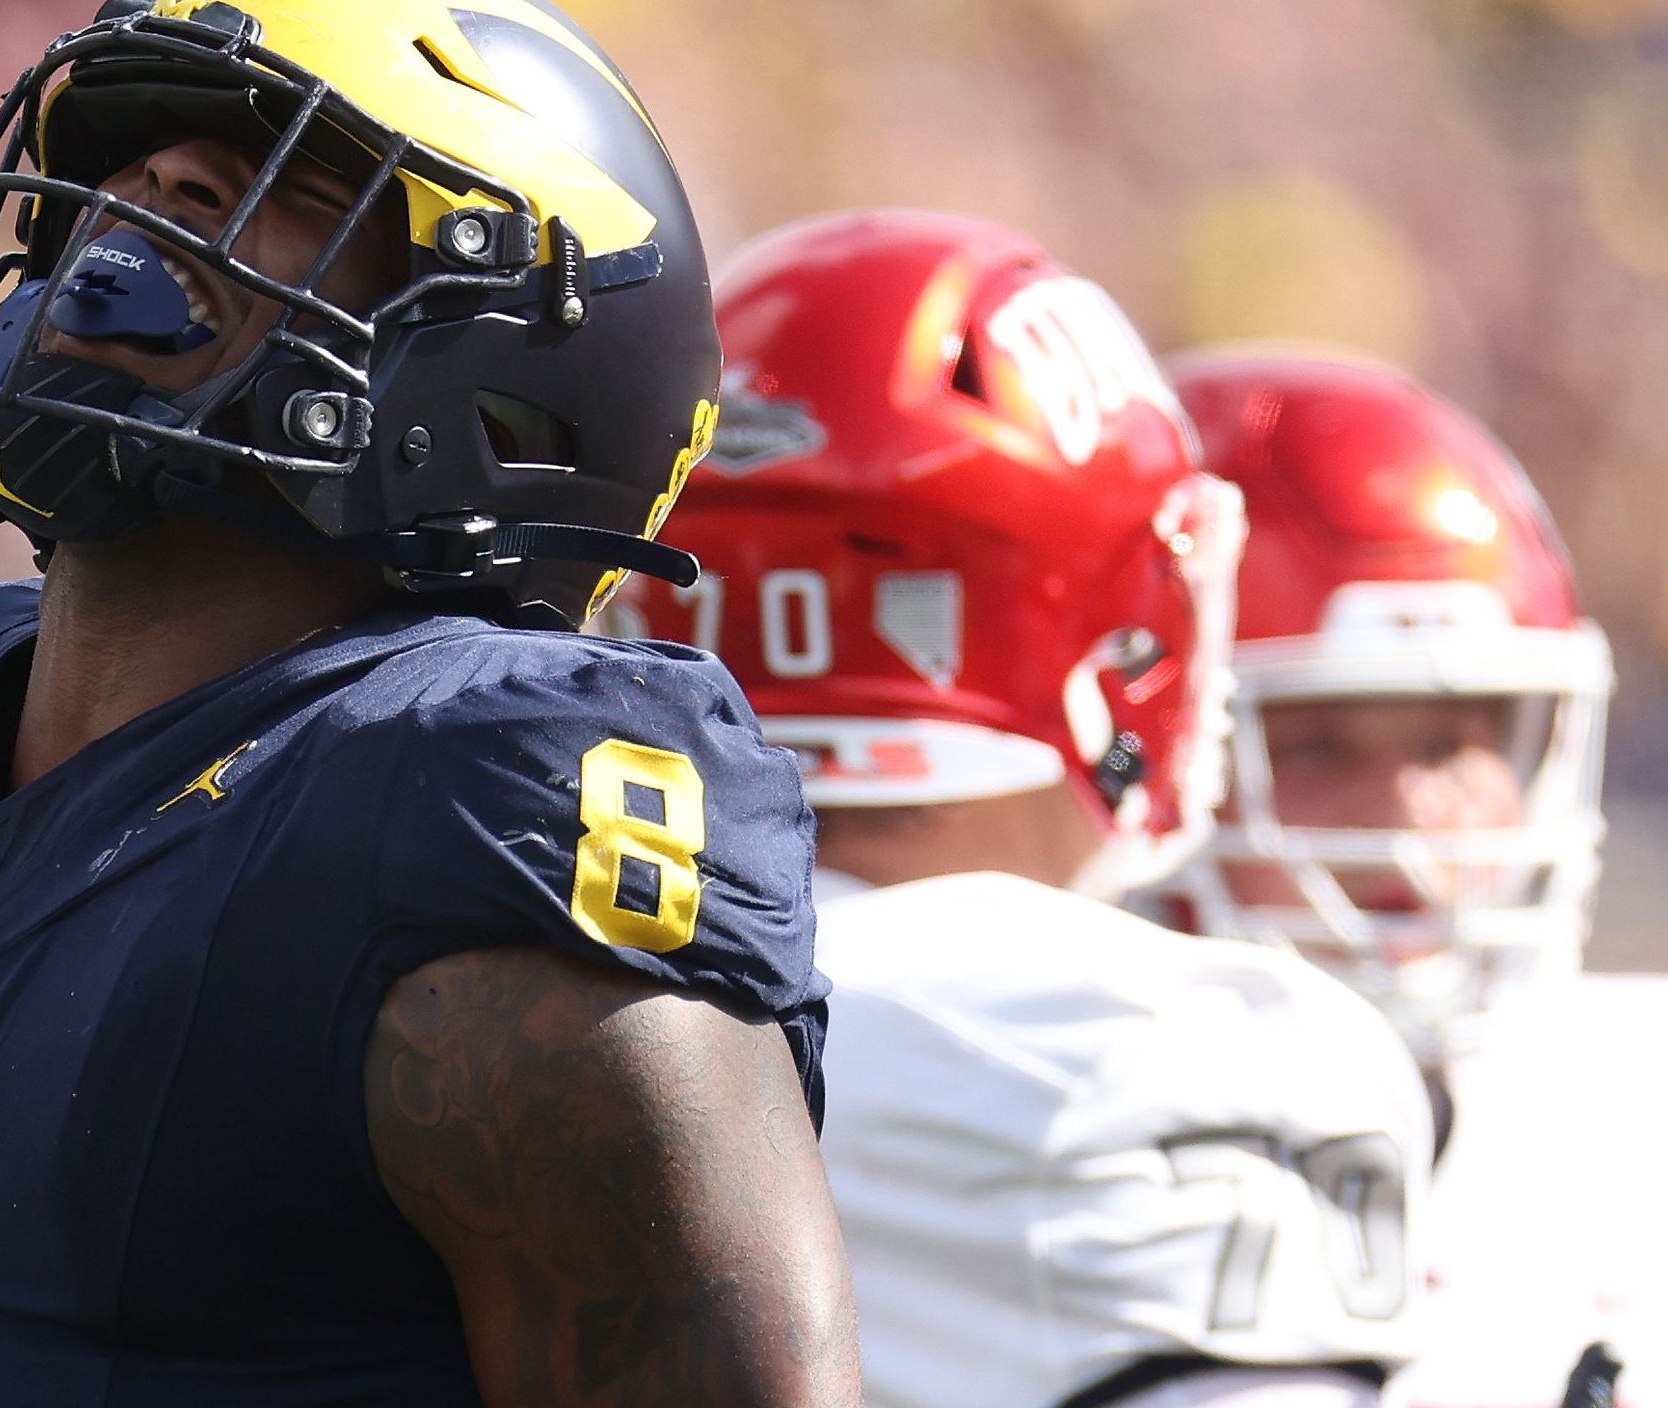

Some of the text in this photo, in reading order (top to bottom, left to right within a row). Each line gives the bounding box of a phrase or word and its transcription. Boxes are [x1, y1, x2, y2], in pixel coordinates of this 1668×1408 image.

[86, 245, 146, 272] SHOCK
[670, 567, 830, 679] 70
[570, 738, 706, 954] 8
